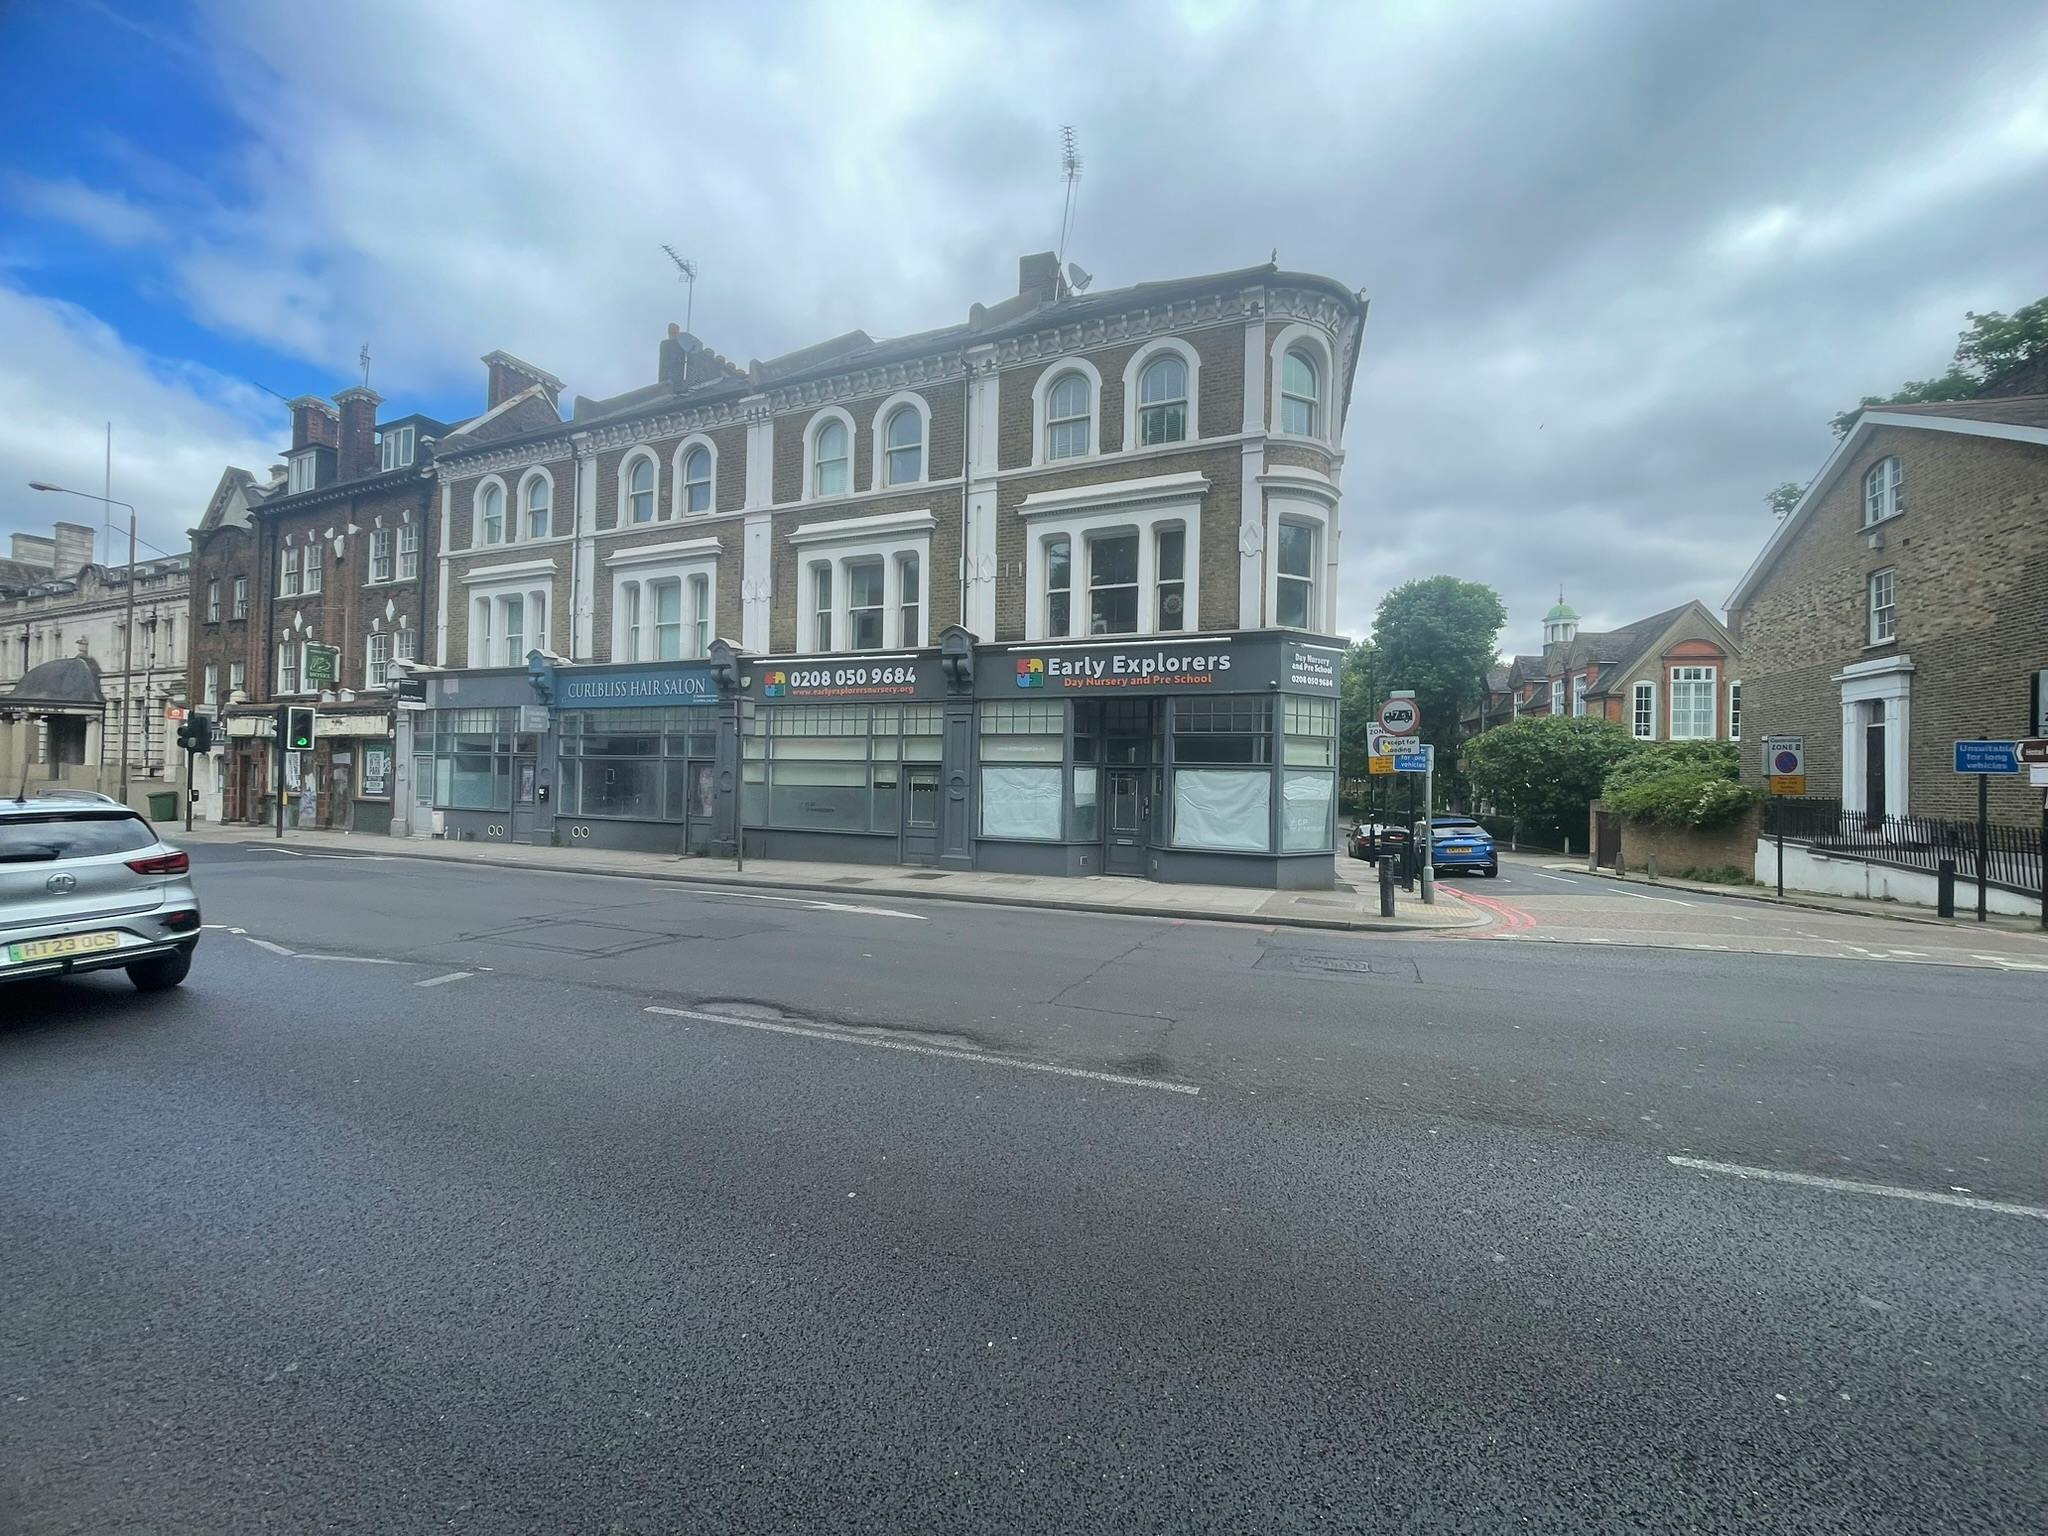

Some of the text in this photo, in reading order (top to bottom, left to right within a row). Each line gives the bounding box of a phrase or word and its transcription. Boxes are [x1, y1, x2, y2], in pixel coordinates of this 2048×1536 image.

[1047, 652, 1231, 679] Early Explorers
[1296, 653, 1306, 663] Day
[791, 666, 916, 688] 0208 050 9684
[1064, 673, 1212, 688] Day Nursery and Pre School
[568, 677, 706, 698] CURLBLISS HAIR SALON
[1966, 761, 2008, 769] vehicles
[1984, 753, 2008, 761] long
[24, 933, 117, 956] HT23 OCS
